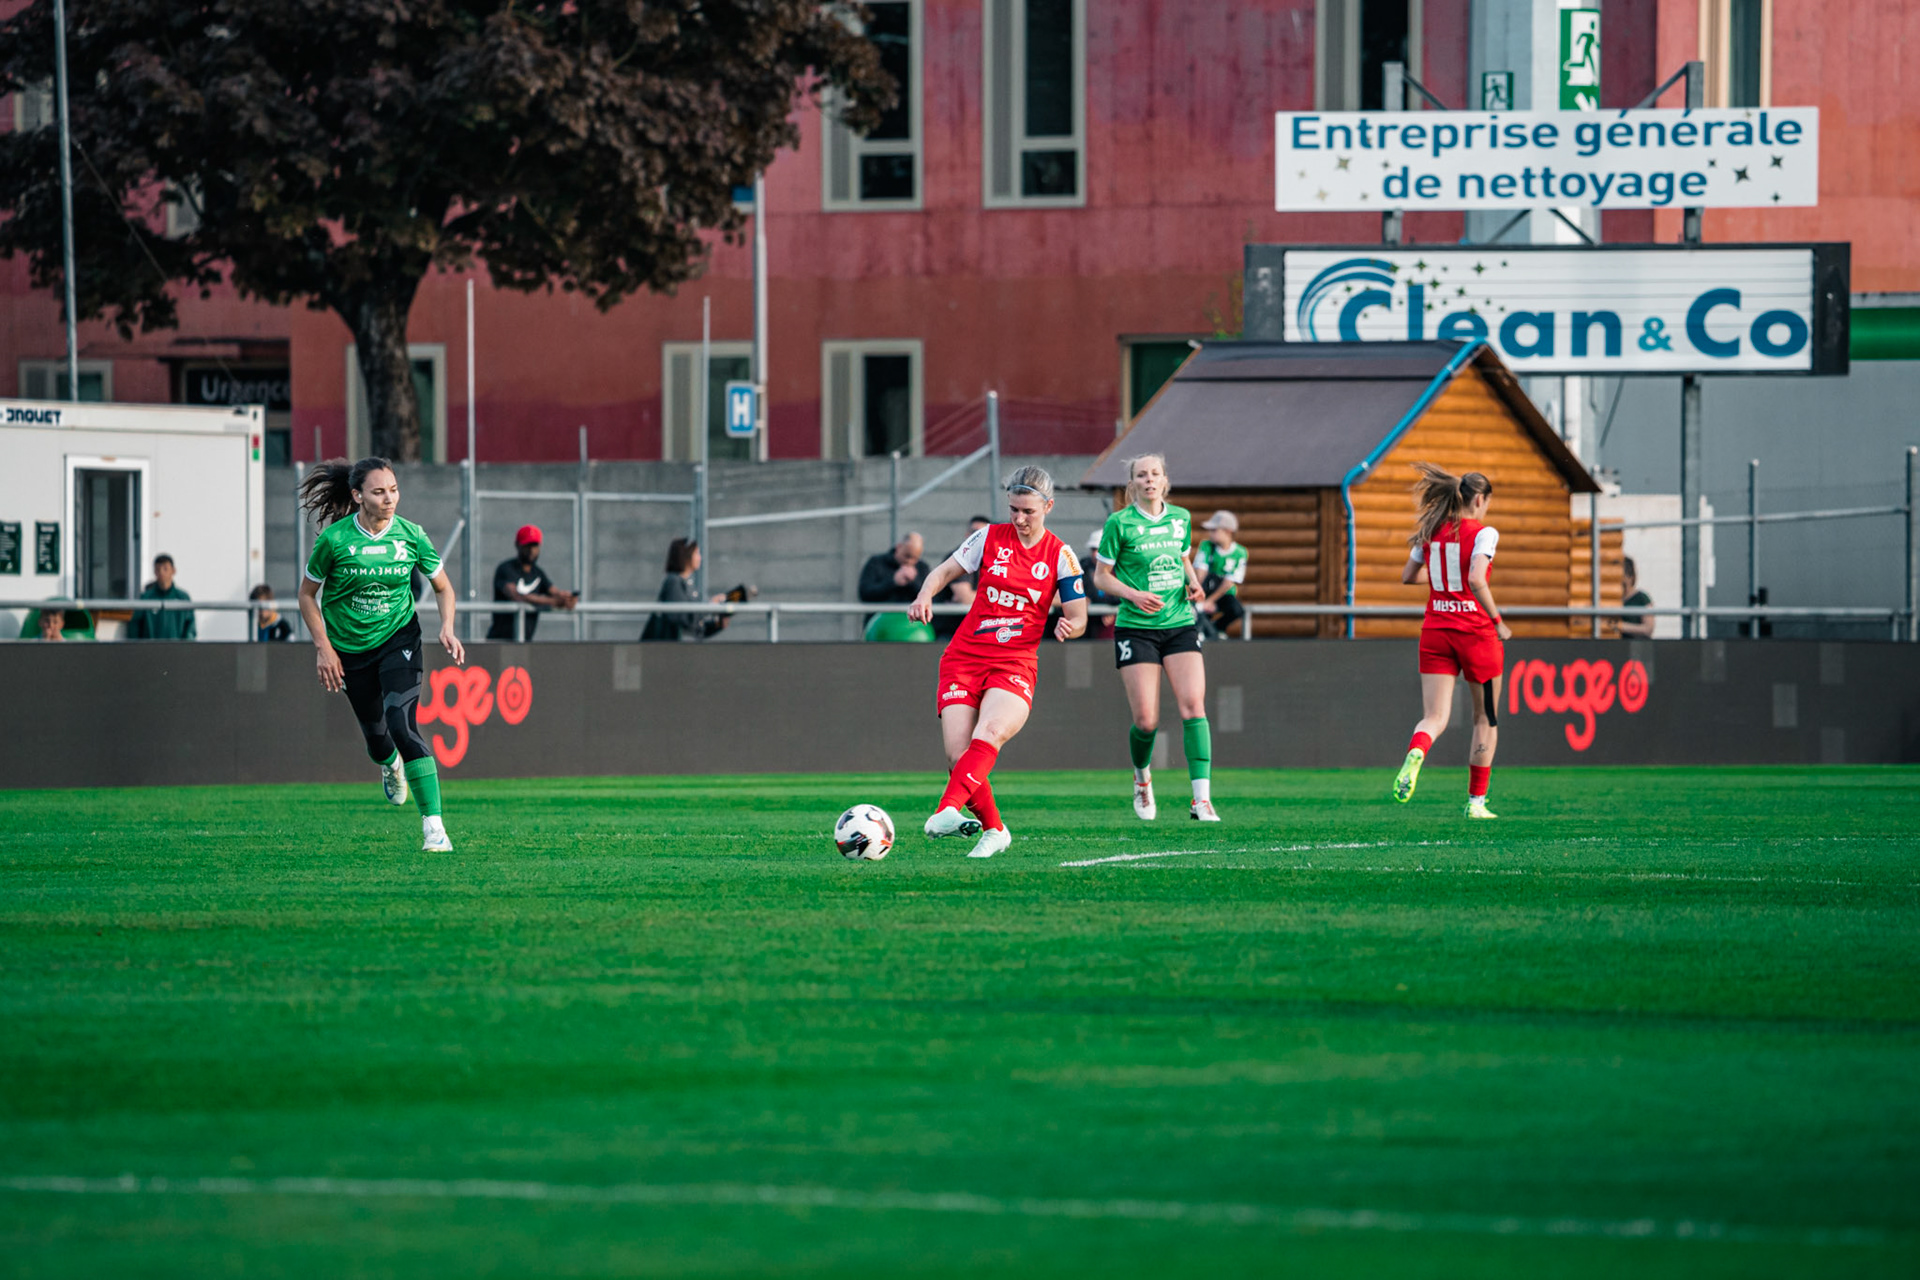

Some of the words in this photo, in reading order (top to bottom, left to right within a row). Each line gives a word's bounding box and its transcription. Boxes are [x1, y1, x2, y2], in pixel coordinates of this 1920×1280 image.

[1292, 115, 1559, 156] Entreprise
[1574, 106, 1803, 155] générale
[1382, 166, 1441, 198] de
[1458, 166, 1708, 206] nettoyage
[1338, 284, 1622, 357] Clean
[1637, 317, 1673, 351] &
[1686, 288, 1809, 358] Co
[733, 391, 750, 427] H
[1429, 541, 1463, 592] 11
[986, 585, 1030, 611] OBT
[1433, 599, 1477, 612] MEISTER
